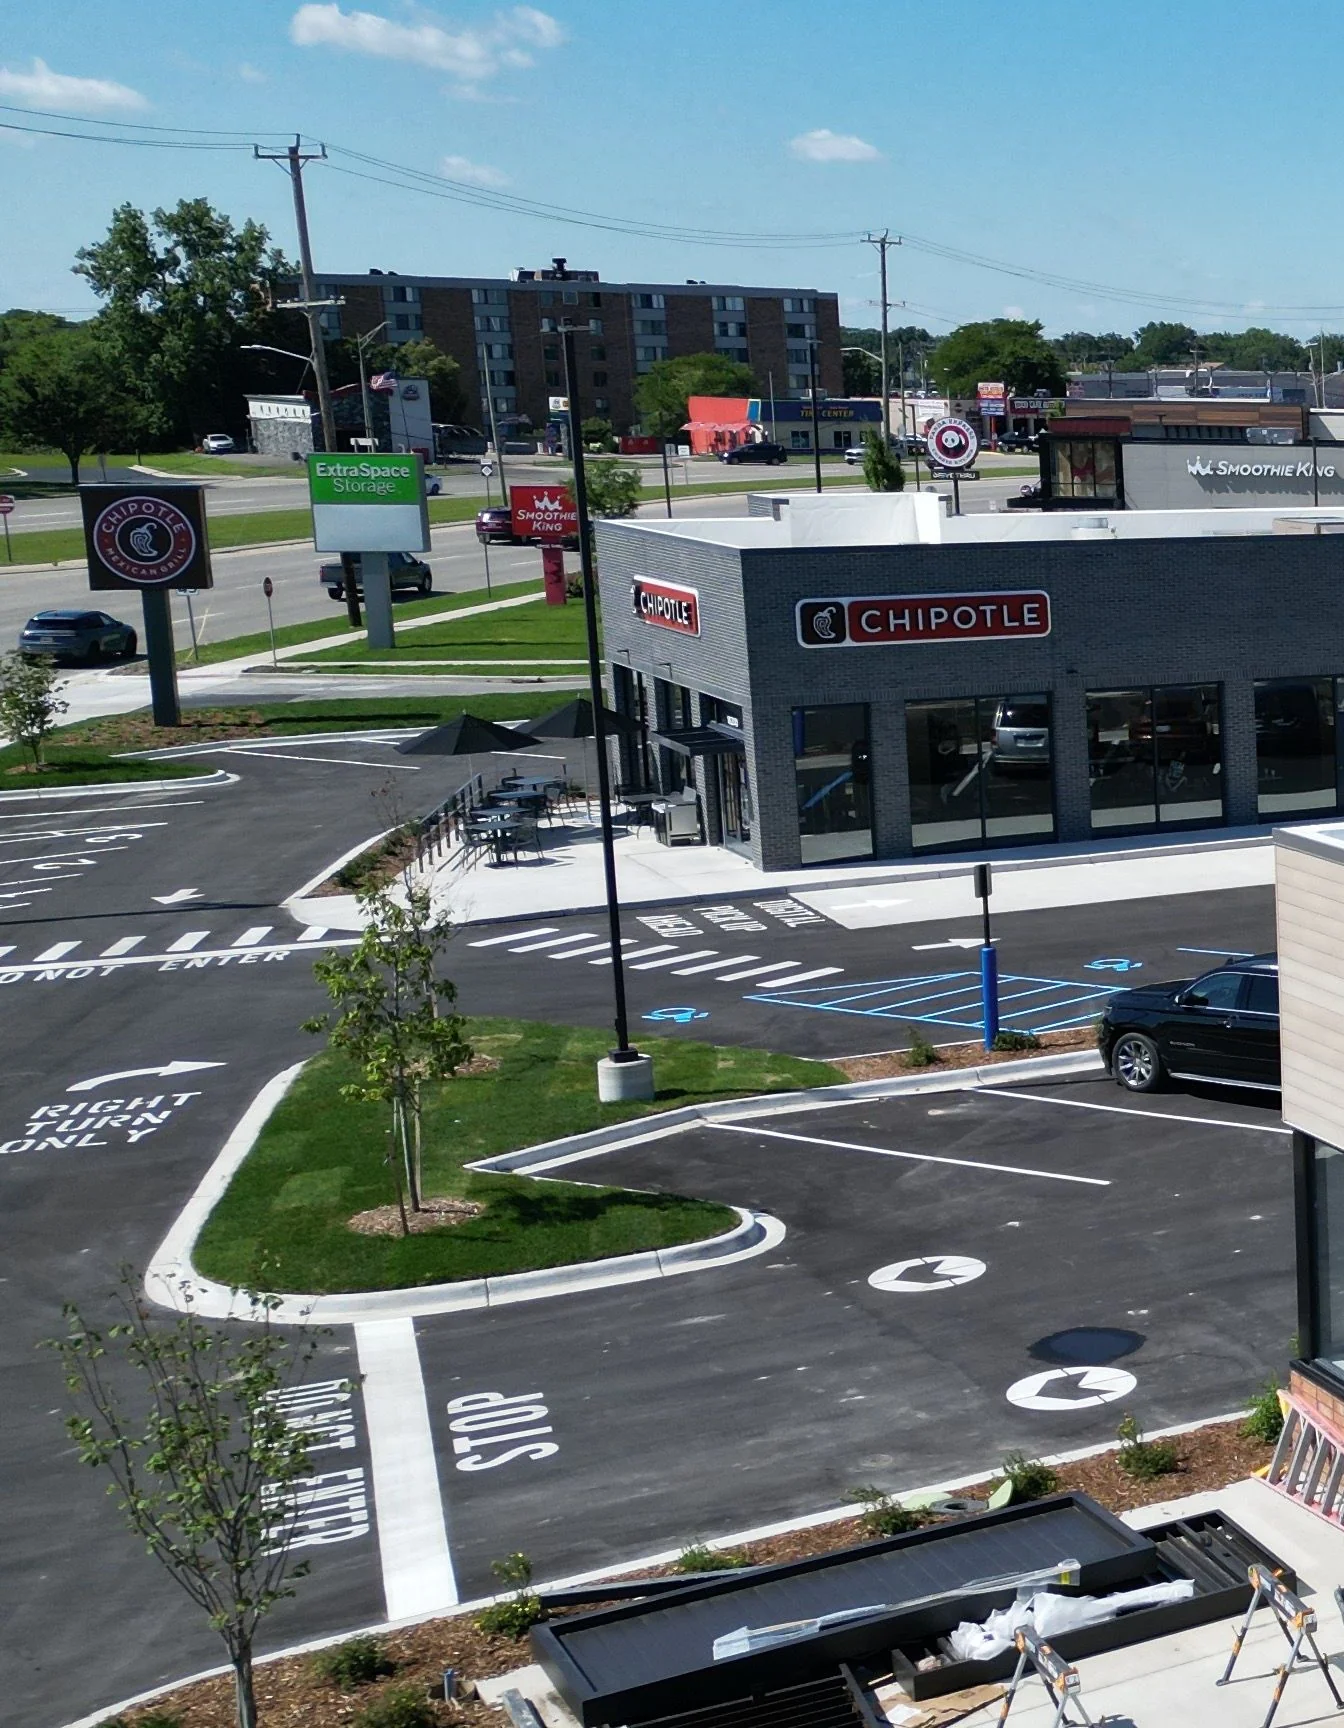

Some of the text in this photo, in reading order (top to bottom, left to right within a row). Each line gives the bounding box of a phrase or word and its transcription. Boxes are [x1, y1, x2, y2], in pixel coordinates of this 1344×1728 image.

[1215, 460, 1336, 477] SMOOTHIE KING
[333, 477, 396, 496] Storage
[101, 502, 187, 534] CHIPOTLE
[516, 509, 577, 521] SMOOTHIE
[105, 547, 157, 576] MEXICAN
[640, 591, 689, 625] CHIPOTLE
[860, 603, 1041, 634] CHIPOTLE
[33, 964, 125, 982] NOT
[158, 950, 291, 972] ENTER
[30, 1091, 202, 1120] RIGHT
[25, 1110, 172, 1136] TURN
[0, 1127, 157, 1154] ONLY
[446, 1391, 560, 1472] STOP
[260, 1467, 371, 1557] ENTER
